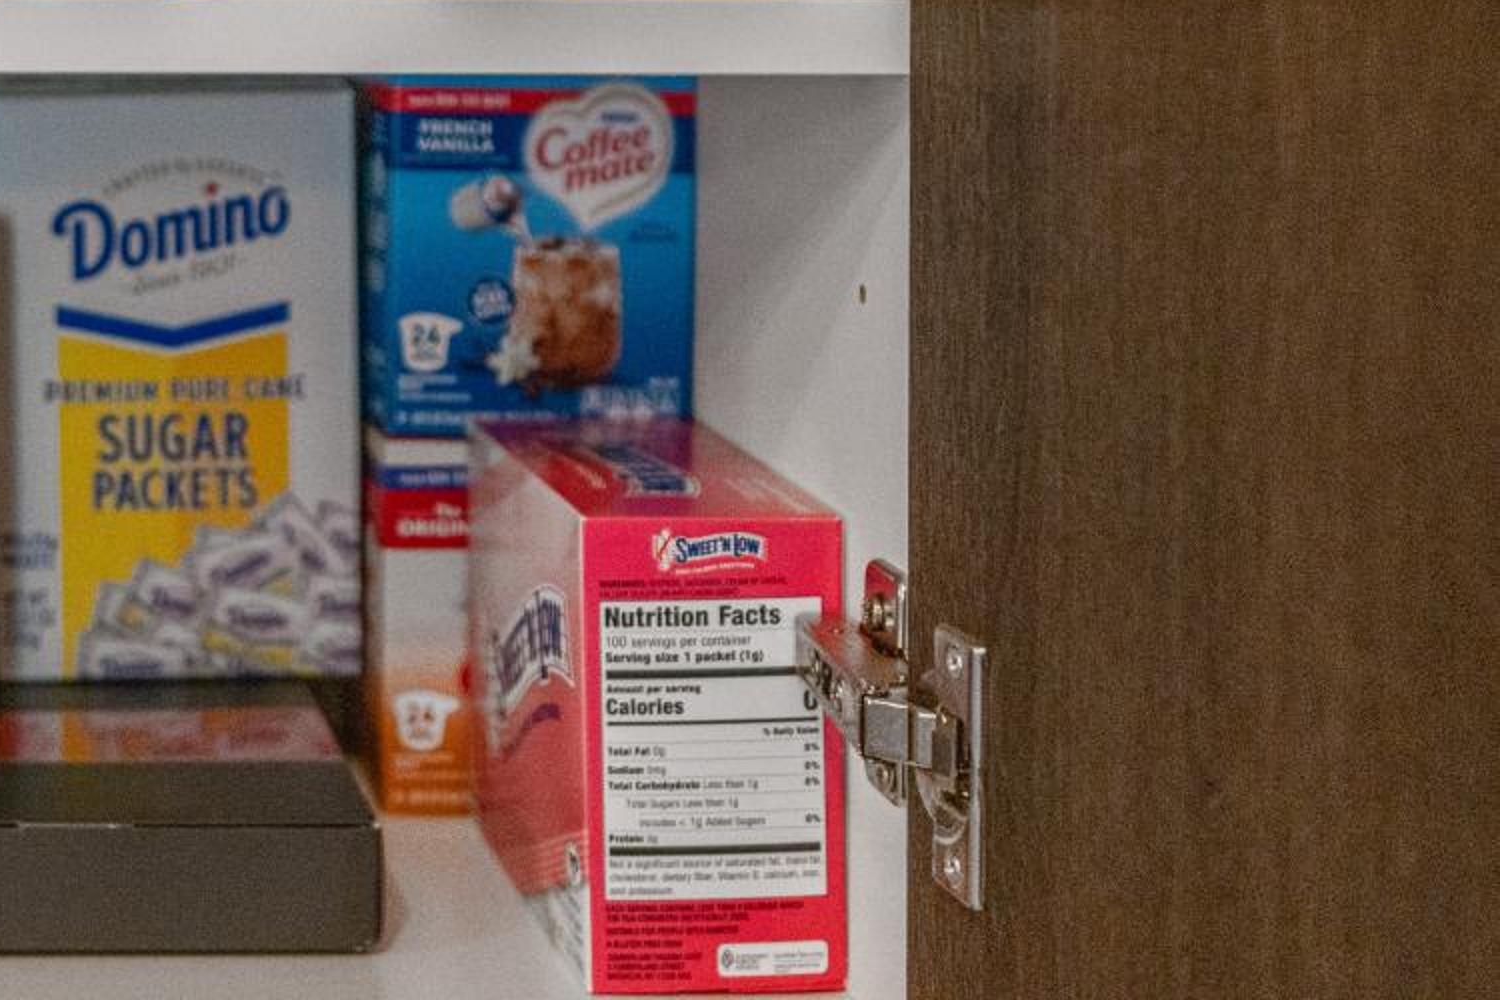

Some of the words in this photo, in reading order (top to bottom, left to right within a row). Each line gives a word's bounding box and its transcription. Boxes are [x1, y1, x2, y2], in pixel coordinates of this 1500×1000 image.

[419, 117, 493, 135] FRENCH
[418, 136, 495, 152] VANILLA
[535, 124, 653, 171] Coffee
[564, 151, 656, 192] mate
[52, 181, 291, 283] Domino
[97, 411, 249, 463] SUGAR
[92, 467, 259, 511] PACKETS
[605, 606, 708, 628] Nutrition
[719, 605, 781, 625] Facts
[606, 636, 627, 648] 100
[631, 637, 677, 648] servings
[680, 637, 697, 648] per
[701, 634, 752, 646] container
[605, 651, 650, 665] Serving
[655, 652, 679, 663] size
[685, 651, 691, 662] 1
[695, 650, 736, 663] packet
[739, 650, 765, 663] (1g)
[606, 698, 685, 715] Calories
[608, 746, 633, 757] Total
[635, 746, 651, 757] Fat
[609, 780, 633, 791] Total
